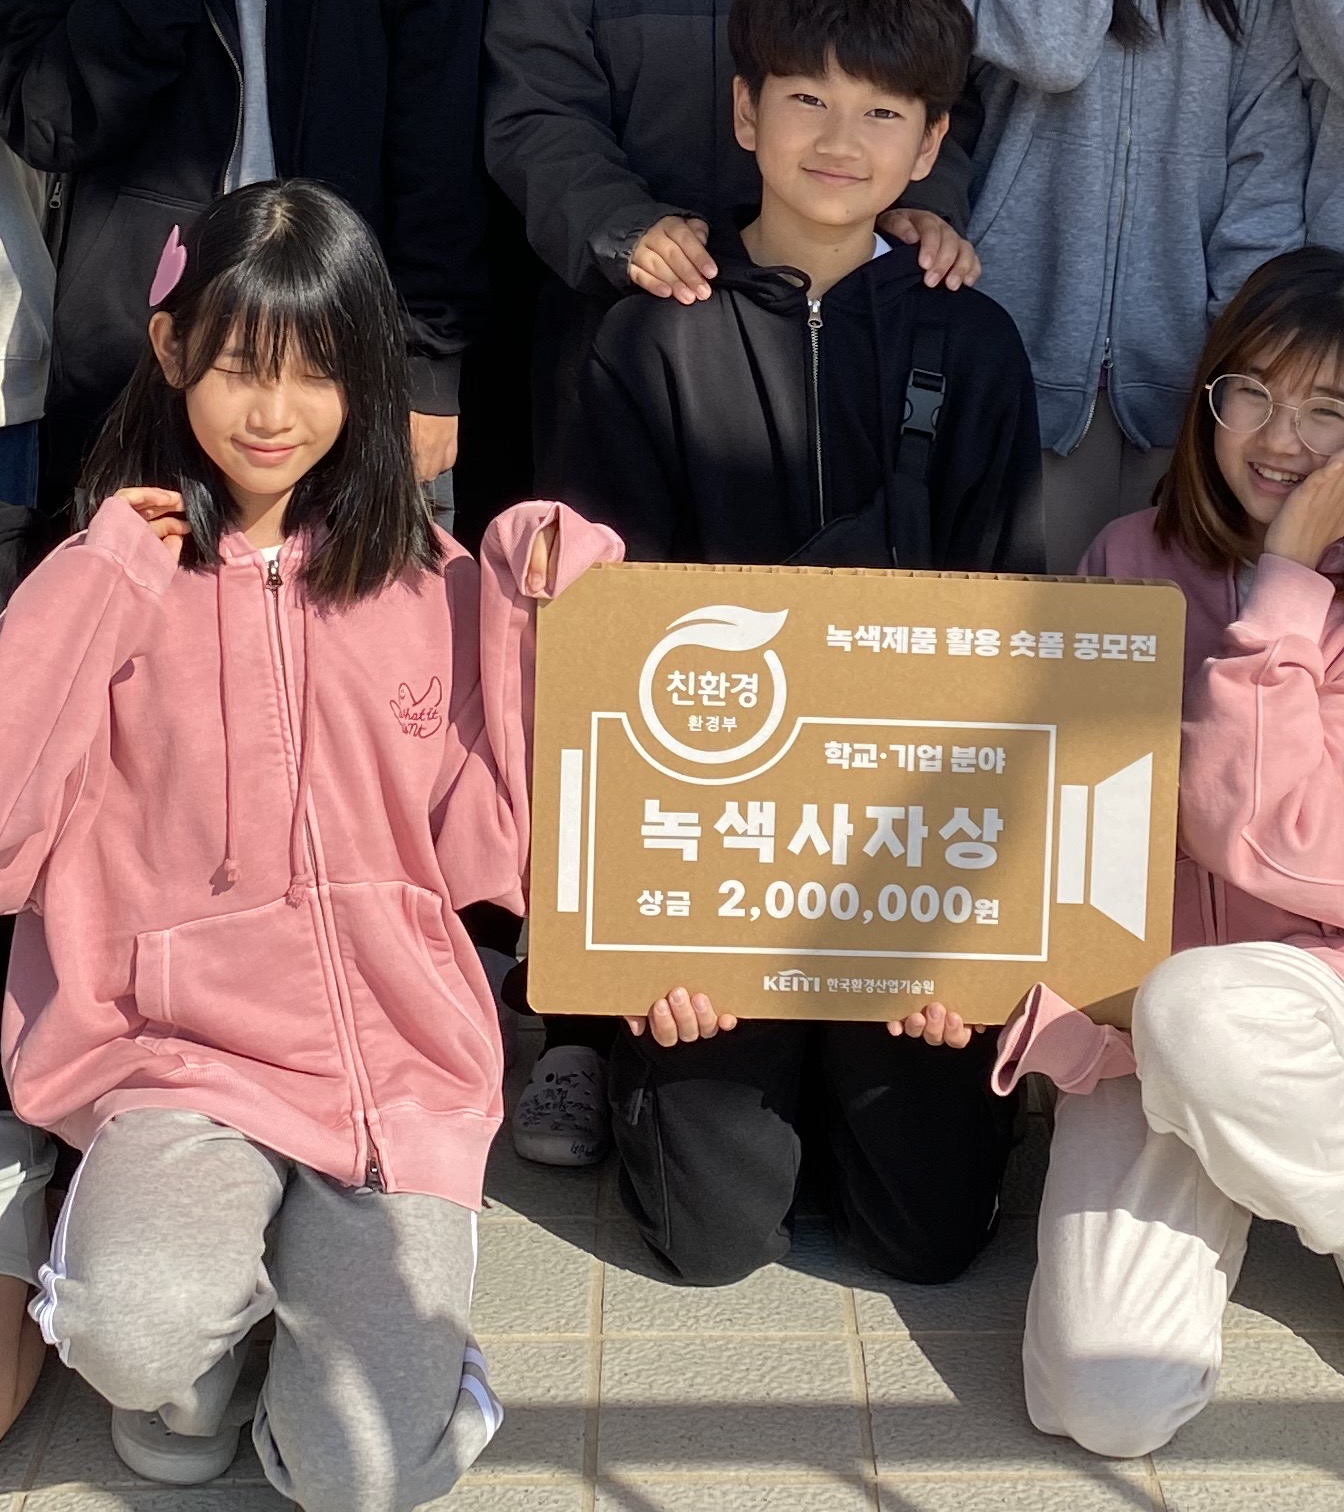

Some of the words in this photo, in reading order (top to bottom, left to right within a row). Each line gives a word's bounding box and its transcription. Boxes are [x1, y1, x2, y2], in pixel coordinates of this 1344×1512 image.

[826, 624, 938, 655] 녹색제품
[945, 626, 1001, 657] 활용
[1009, 630, 1065, 660] 숏폼
[1072, 632, 1157, 663] 공모전
[666, 670, 759, 709] 친환경
[687, 715, 738, 733] 환경부
[950, 745, 1006, 775] 분야
[640, 798, 1005, 870] 녹색사자상
[636, 889, 691, 917] 상금
[717, 879, 1000, 925] 2,000,000원
[763, 973, 821, 993] KEITI
[826, 977, 935, 995] 한국환경산업기술원
